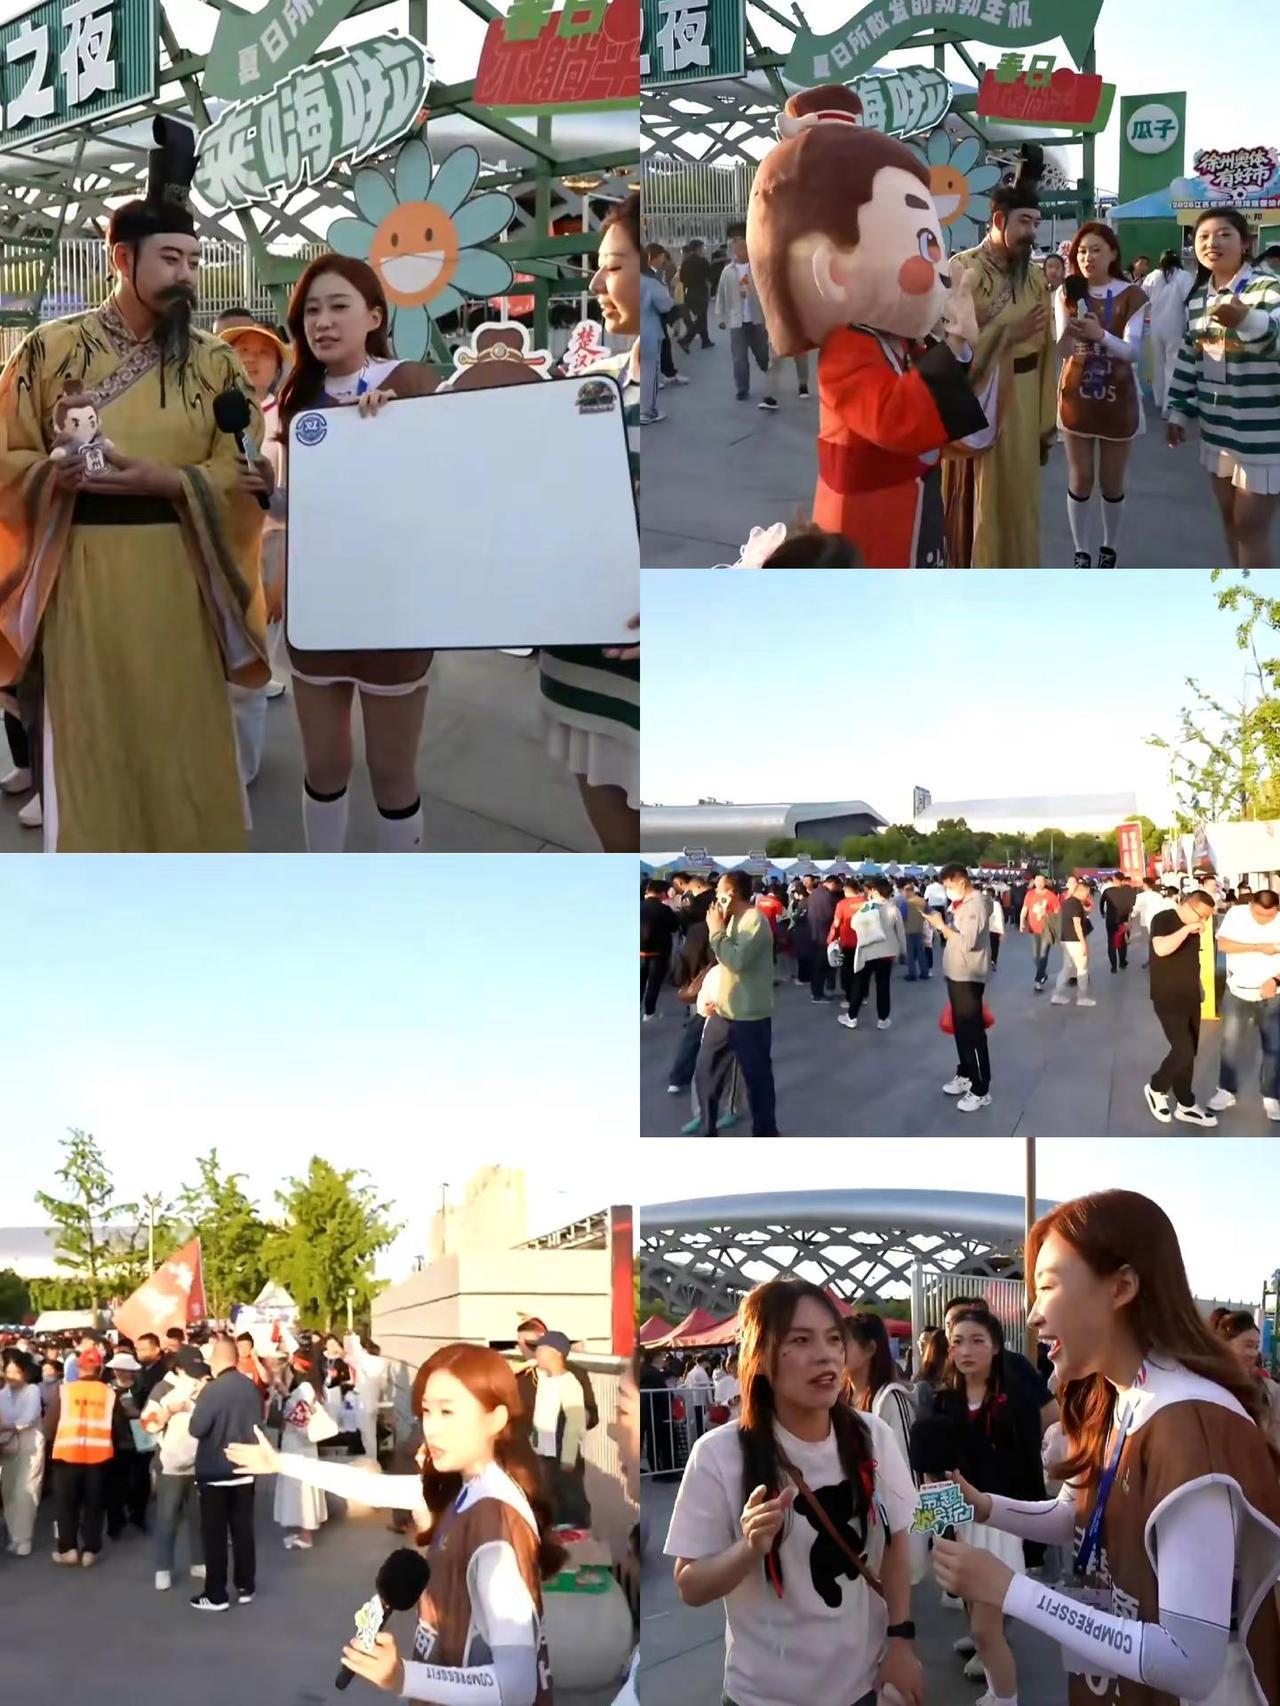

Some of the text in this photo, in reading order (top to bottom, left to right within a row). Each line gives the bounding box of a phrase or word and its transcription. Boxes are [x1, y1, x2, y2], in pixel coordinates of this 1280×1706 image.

[640, 0, 710, 71] 夜
[196, 42, 420, 203] 来嗨啦
[1131, 119, 1176, 141] 瓜子
[1198, 149, 1270, 172] 徐州奥体
[1037, 1594, 1133, 1655] COMPRESSFIT
